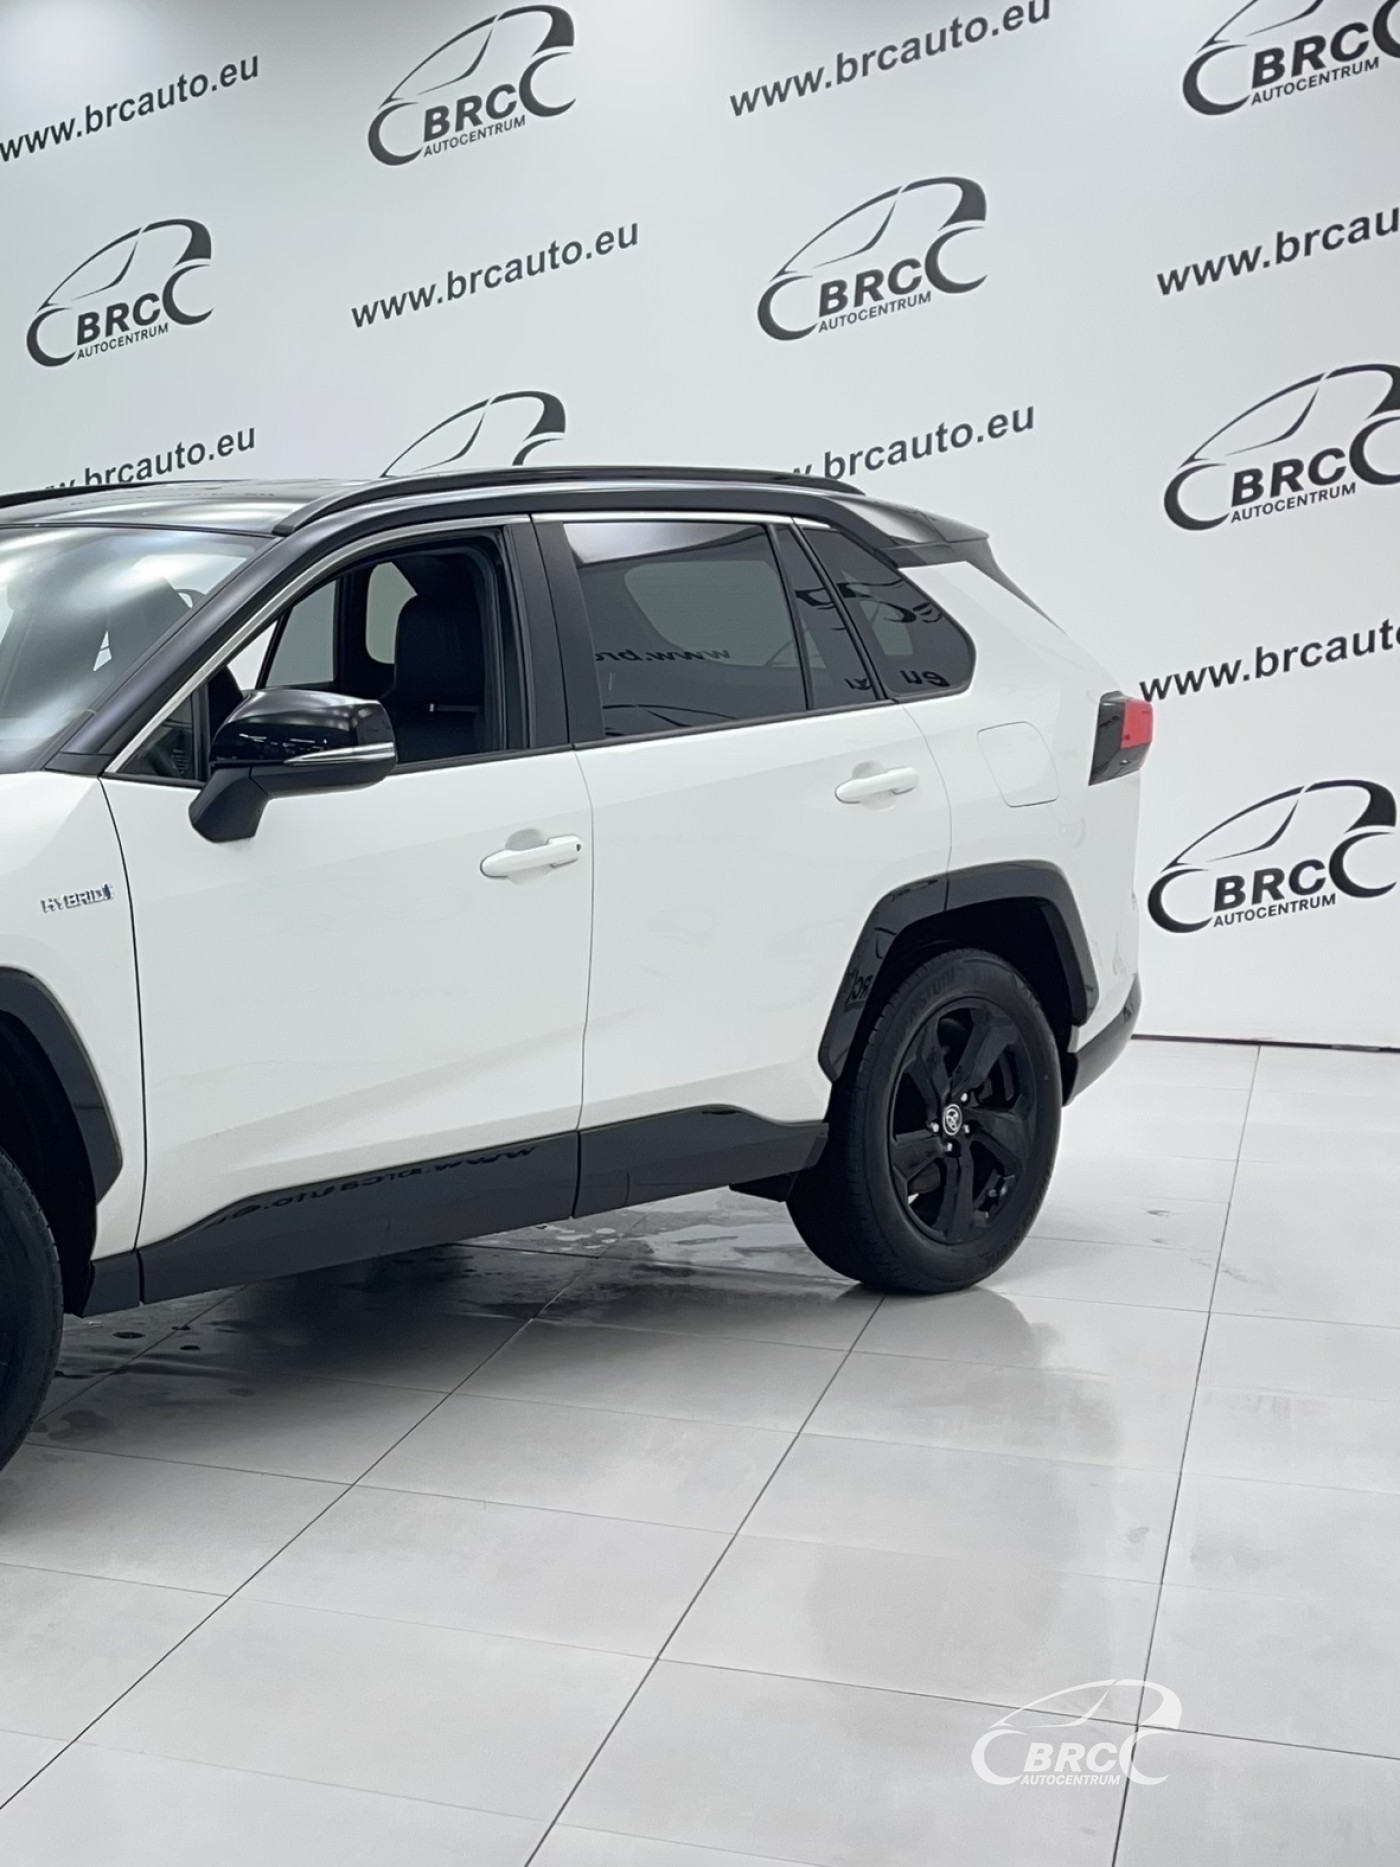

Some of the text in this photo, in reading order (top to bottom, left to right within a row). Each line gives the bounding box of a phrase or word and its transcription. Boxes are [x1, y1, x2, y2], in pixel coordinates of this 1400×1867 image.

[730, 0, 1049, 117] www.brcauto.eu
[1251, 57, 1379, 106] AUTOCENTRUM
[1252, 22, 1369, 89] BRC
[0, 55, 259, 162] www.brcauto.eu
[424, 83, 518, 142] BRC
[424, 115, 525, 157] AUTOCENTRUM
[352, 222, 638, 328] www.brcauto.eu
[1157, 208, 1400, 295] www.brcau
[819, 258, 921, 318] BRC
[819, 291, 931, 333] AUTOCENTRUM
[77, 293, 159, 346] BRC
[77, 322, 168, 359] AUTOCENTRUM
[793, 407, 1033, 480] brcauto.eu
[1231, 448, 1346, 507] BRC
[1231, 482, 1355, 524] AUTOCENTRUM
[1140, 619, 1400, 703] www.brcaut
[1214, 857, 1325, 912] BRC
[1214, 892, 1335, 928] AUTOCENTRUM
